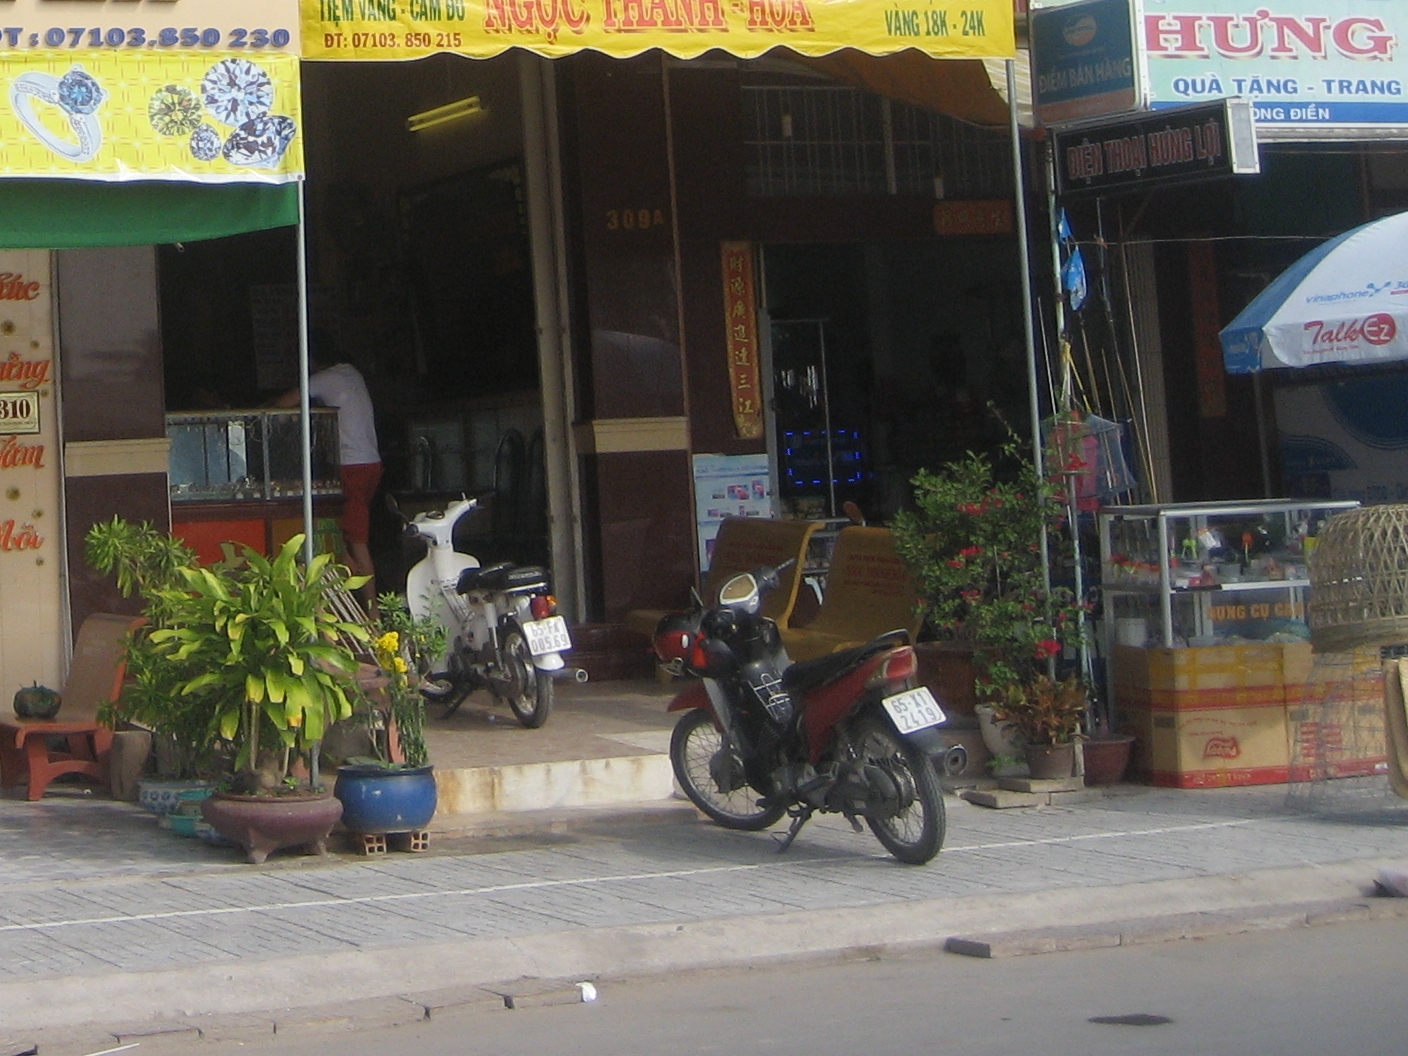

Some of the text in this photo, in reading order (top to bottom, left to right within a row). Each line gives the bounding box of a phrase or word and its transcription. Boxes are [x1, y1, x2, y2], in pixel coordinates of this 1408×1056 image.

[884, 4, 986, 36] VÀNG 18K 24K
[230, 27, 290, 47] 230
[405, 32, 431, 48] 850
[435, 32, 462, 48] 215
[1144, 9, 1396, 59] HƯNG
[1173, 73, 1402, 99] QUÀ TẶNG TRANG
